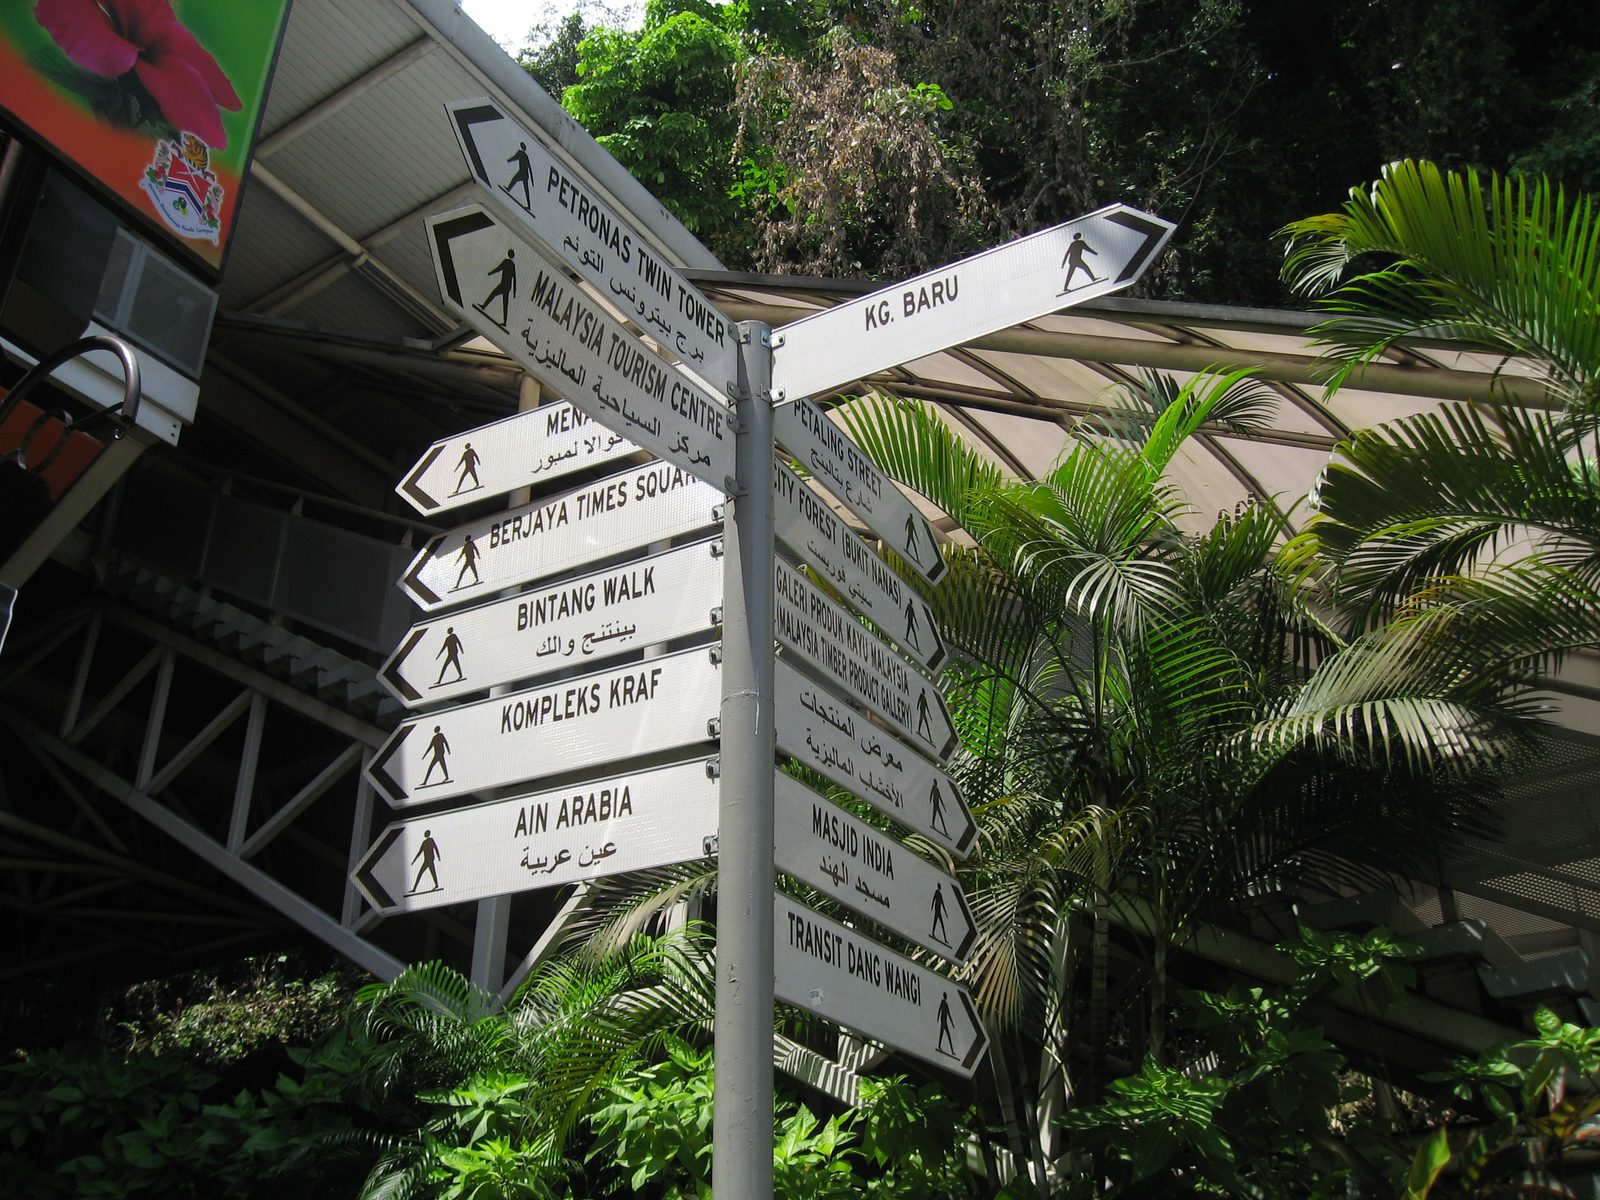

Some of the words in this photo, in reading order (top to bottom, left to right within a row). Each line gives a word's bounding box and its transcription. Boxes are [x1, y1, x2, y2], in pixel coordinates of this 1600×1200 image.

[547, 165, 632, 264] PETRONAS
[637, 247, 672, 302] TWIN
[678, 284, 725, 348] TOWER
[865, 300, 894, 331] KG.
[903, 275, 958, 317] BARU
[521, 318, 587, 387] الماليزية
[531, 270, 606, 358] MALAYSIA
[607, 332, 668, 403] TOURISM
[671, 381, 724, 441] CENTRE
[675, 330, 705, 364] برج
[592, 375, 661, 438] السياحية
[667, 431, 711, 467] مركز
[793, 399, 844, 462] PETALING
[847, 447, 882, 500] STREET
[489, 501, 569, 549] BERJAYA
[576, 480, 628, 521] TIMES
[635, 464, 702, 501] SQUA
[774, 463, 795, 505] ITY
[799, 487, 838, 546] FOREST
[841, 526, 869, 577] (BUKIT
[871, 560, 902, 611] NANAS)
[516, 583, 596, 632] BINTANG
[603, 566, 656, 607] WALK
[776, 565, 808, 615] GALERI
[810, 592, 844, 644] PRODUK
[846, 622, 868, 663] KAYU
[870, 644, 910, 697] MALAYSIA
[776, 599, 820, 661] (MALAYSIA
[820, 636, 848, 683] TIMBER
[848, 658, 880, 706] PRODUCT
[881, 685, 913, 735] GALLERY)
[500, 683, 601, 734] KOMPLEKS
[609, 668, 662, 709] KRAF
[800, 692, 855, 741] المنتجات
[806, 727, 854, 778] الماليزية
[860, 736, 903, 773] معرض
[514, 802, 549, 838] AIN
[556, 785, 633, 830] ARABIA
[812, 804, 858, 858] MASJID
[862, 835, 895, 880] INDIA
[520, 846, 572, 876] عربية
[578, 841, 618, 869] عين
[819, 855, 849, 888] الهند
[854, 875, 891, 909] مسجد
[787, 911, 843, 970] TRANSIT
[847, 942, 881, 988] DANG
[884, 959, 922, 1007] WANGI
